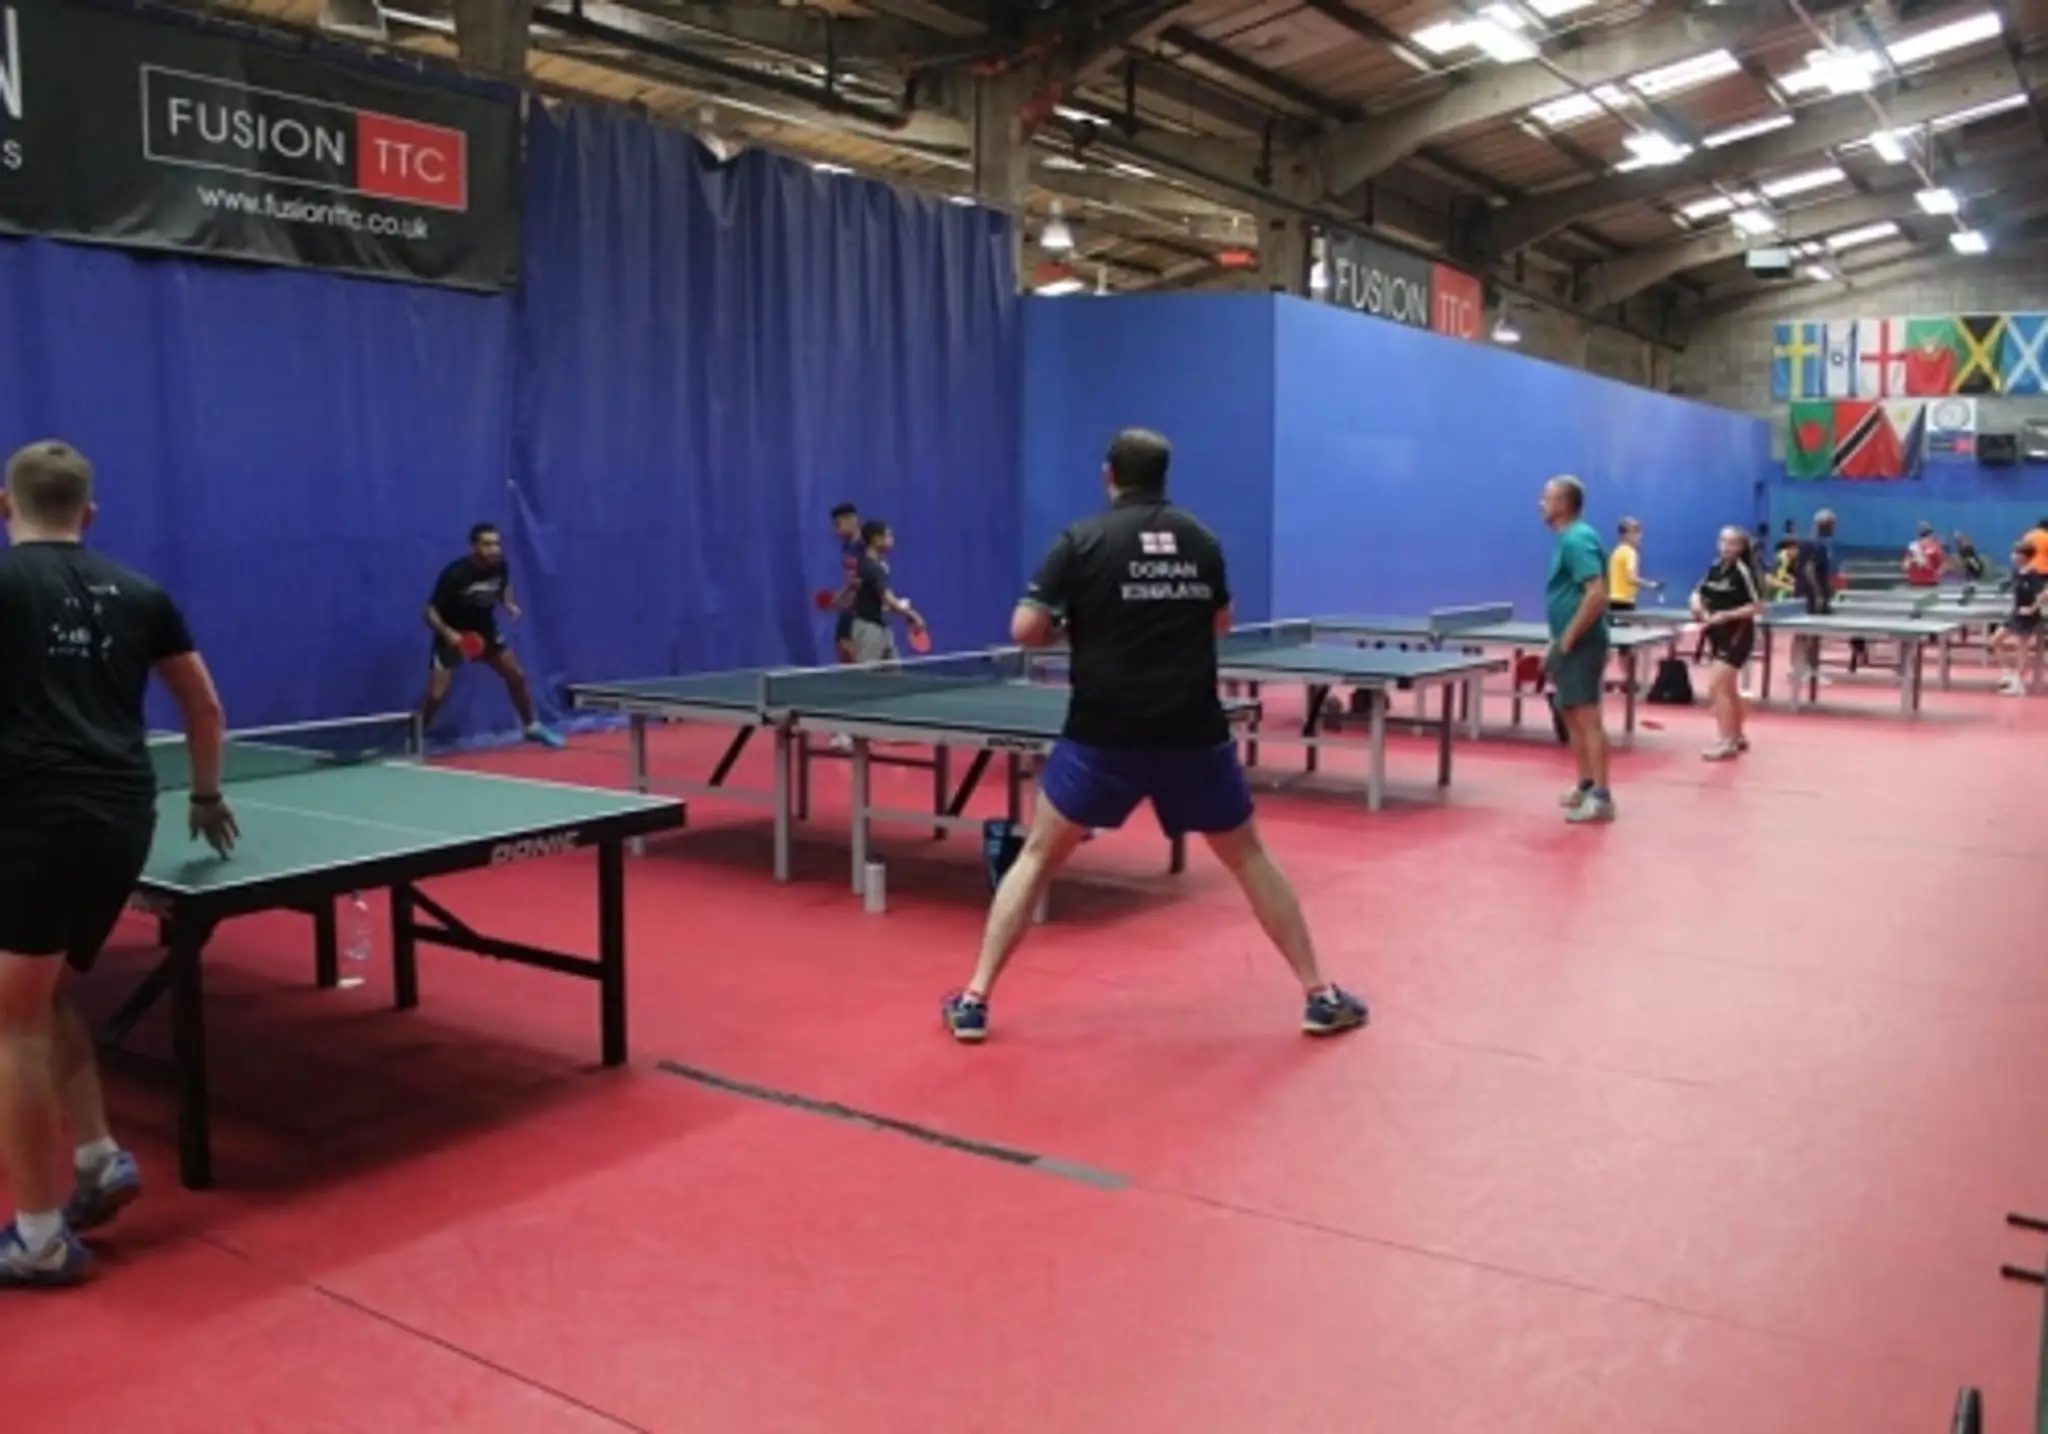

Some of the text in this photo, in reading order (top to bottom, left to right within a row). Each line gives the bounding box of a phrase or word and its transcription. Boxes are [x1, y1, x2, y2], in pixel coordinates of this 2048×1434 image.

[167, 97, 447, 183] FUSION TTC
[197, 186, 428, 239] www.fusionttc.co.uk
[1335, 258, 1473, 339] FUSION TTC
[1128, 560, 1198, 578] DORAN
